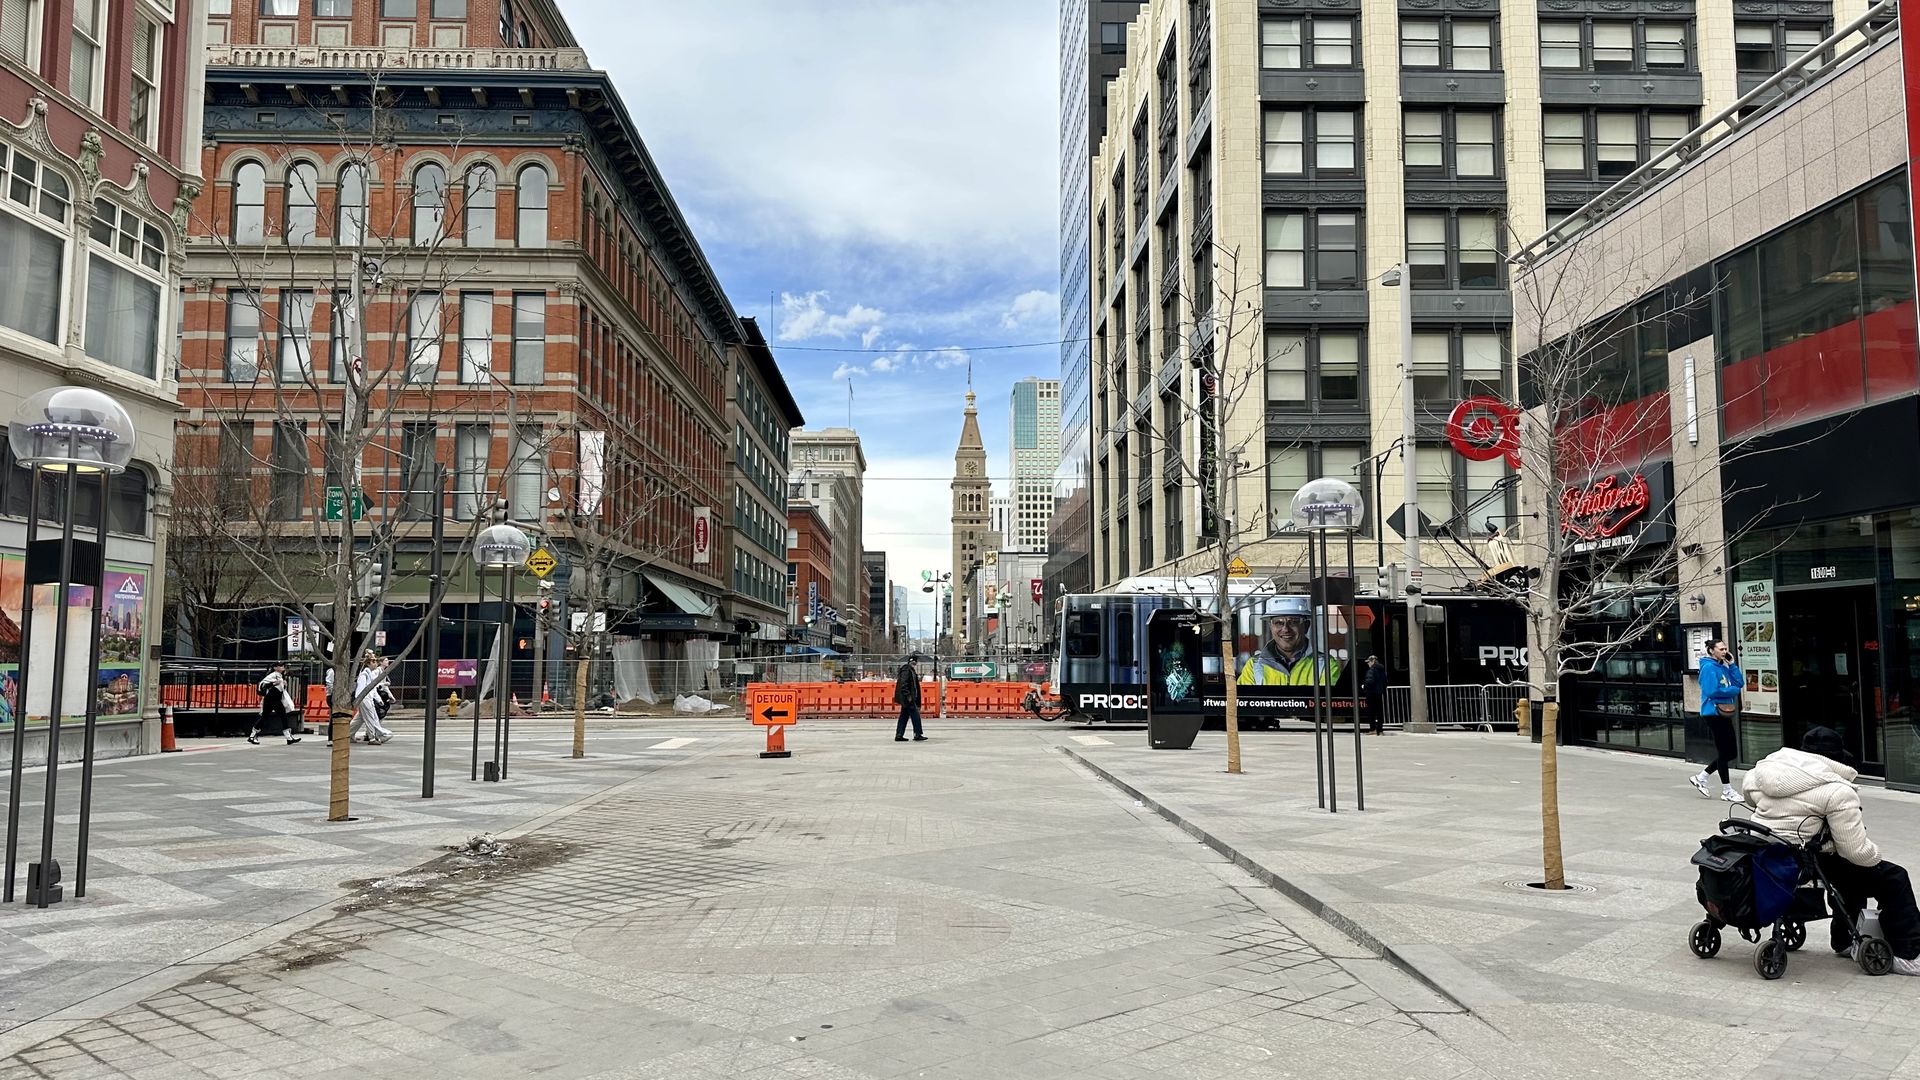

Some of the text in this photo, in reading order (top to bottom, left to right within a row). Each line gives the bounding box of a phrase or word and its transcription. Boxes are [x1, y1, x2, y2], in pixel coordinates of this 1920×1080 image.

[1206, 480, 1216, 530] Juce
[757, 694, 793, 703] DETOUR
[1236, 699, 1248, 707] for
[1249, 699, 1308, 709] construction,
